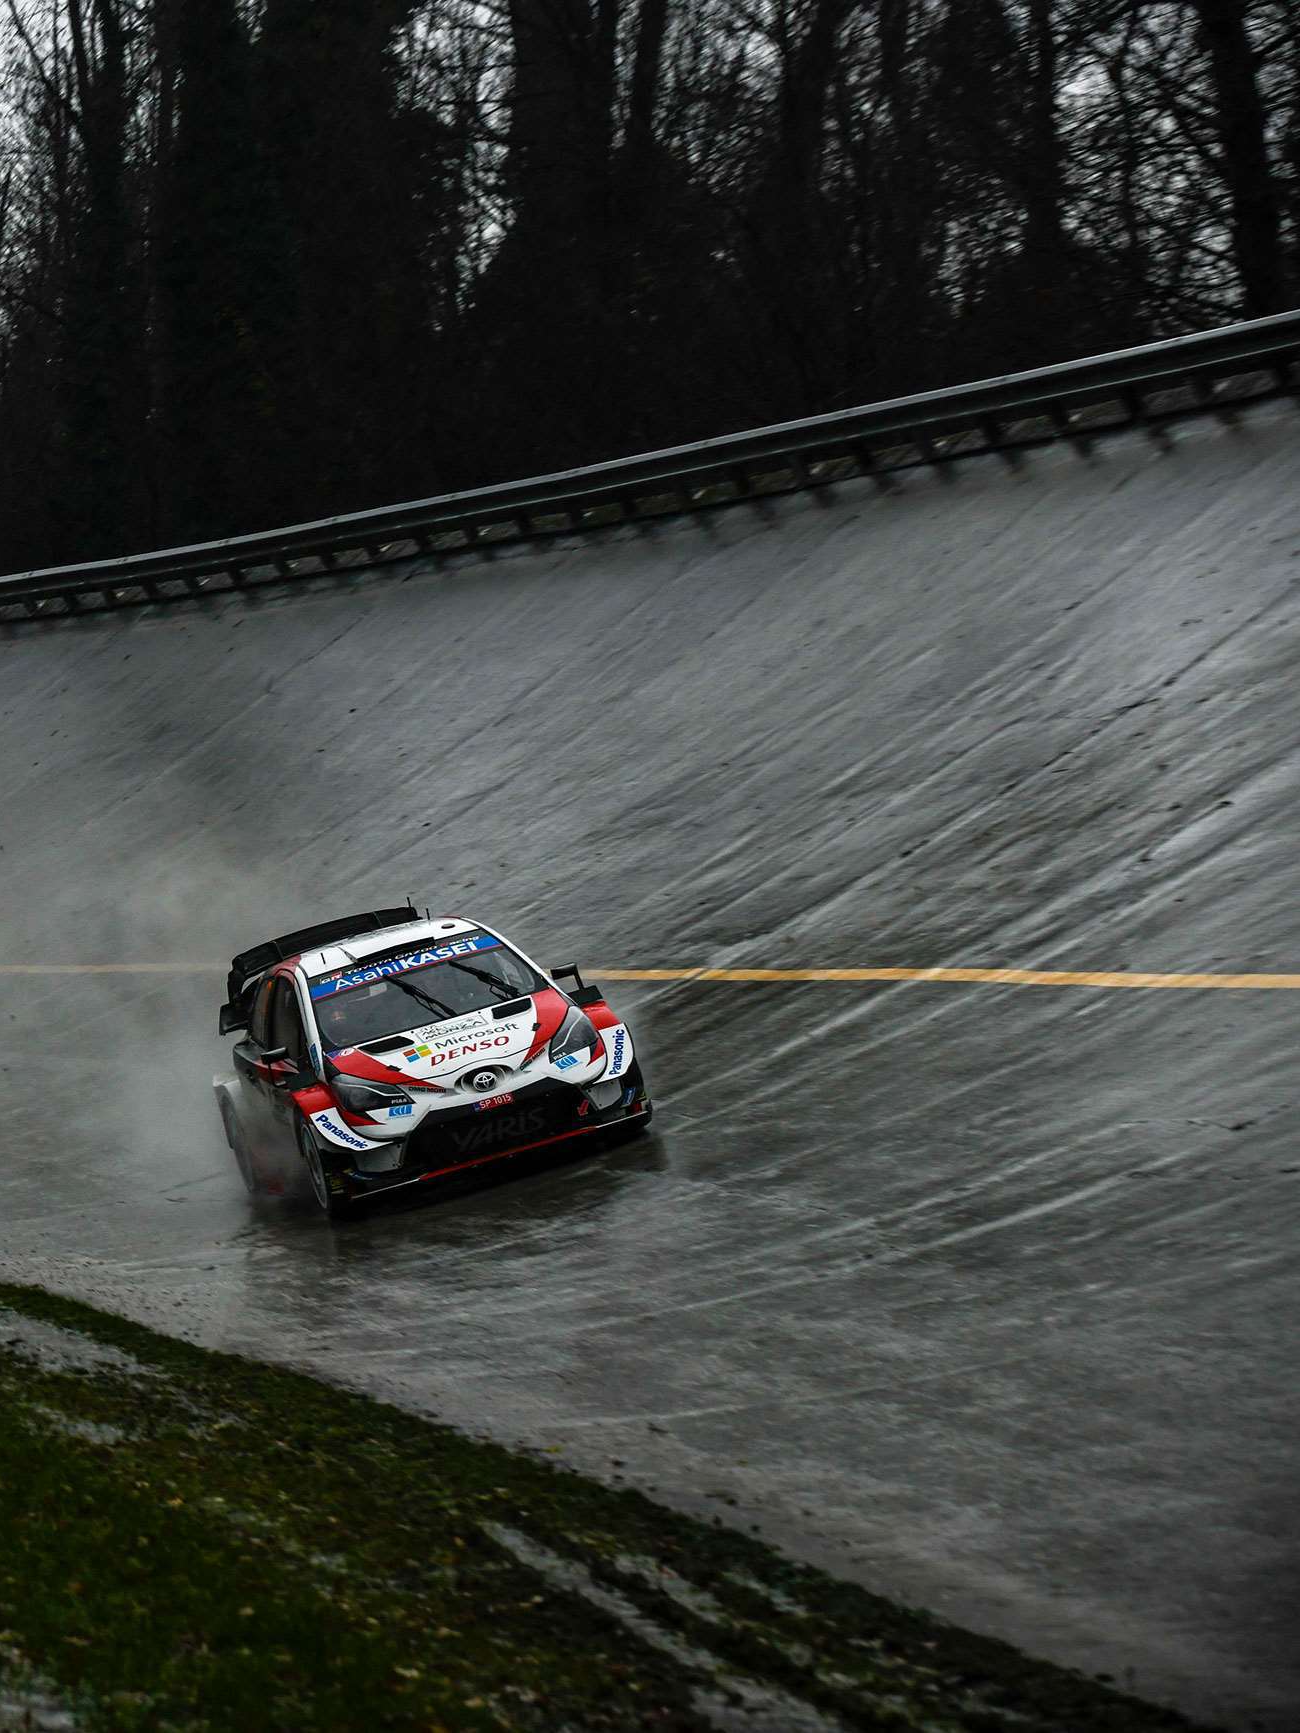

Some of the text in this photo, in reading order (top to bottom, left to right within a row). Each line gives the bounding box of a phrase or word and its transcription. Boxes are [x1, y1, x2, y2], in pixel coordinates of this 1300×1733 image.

[431, 1036, 509, 1066] DENSO
[434, 1022, 520, 1049] Microsoft
[608, 1029, 625, 1076] Panasonic
[315, 1114, 368, 1149] Panasonic
